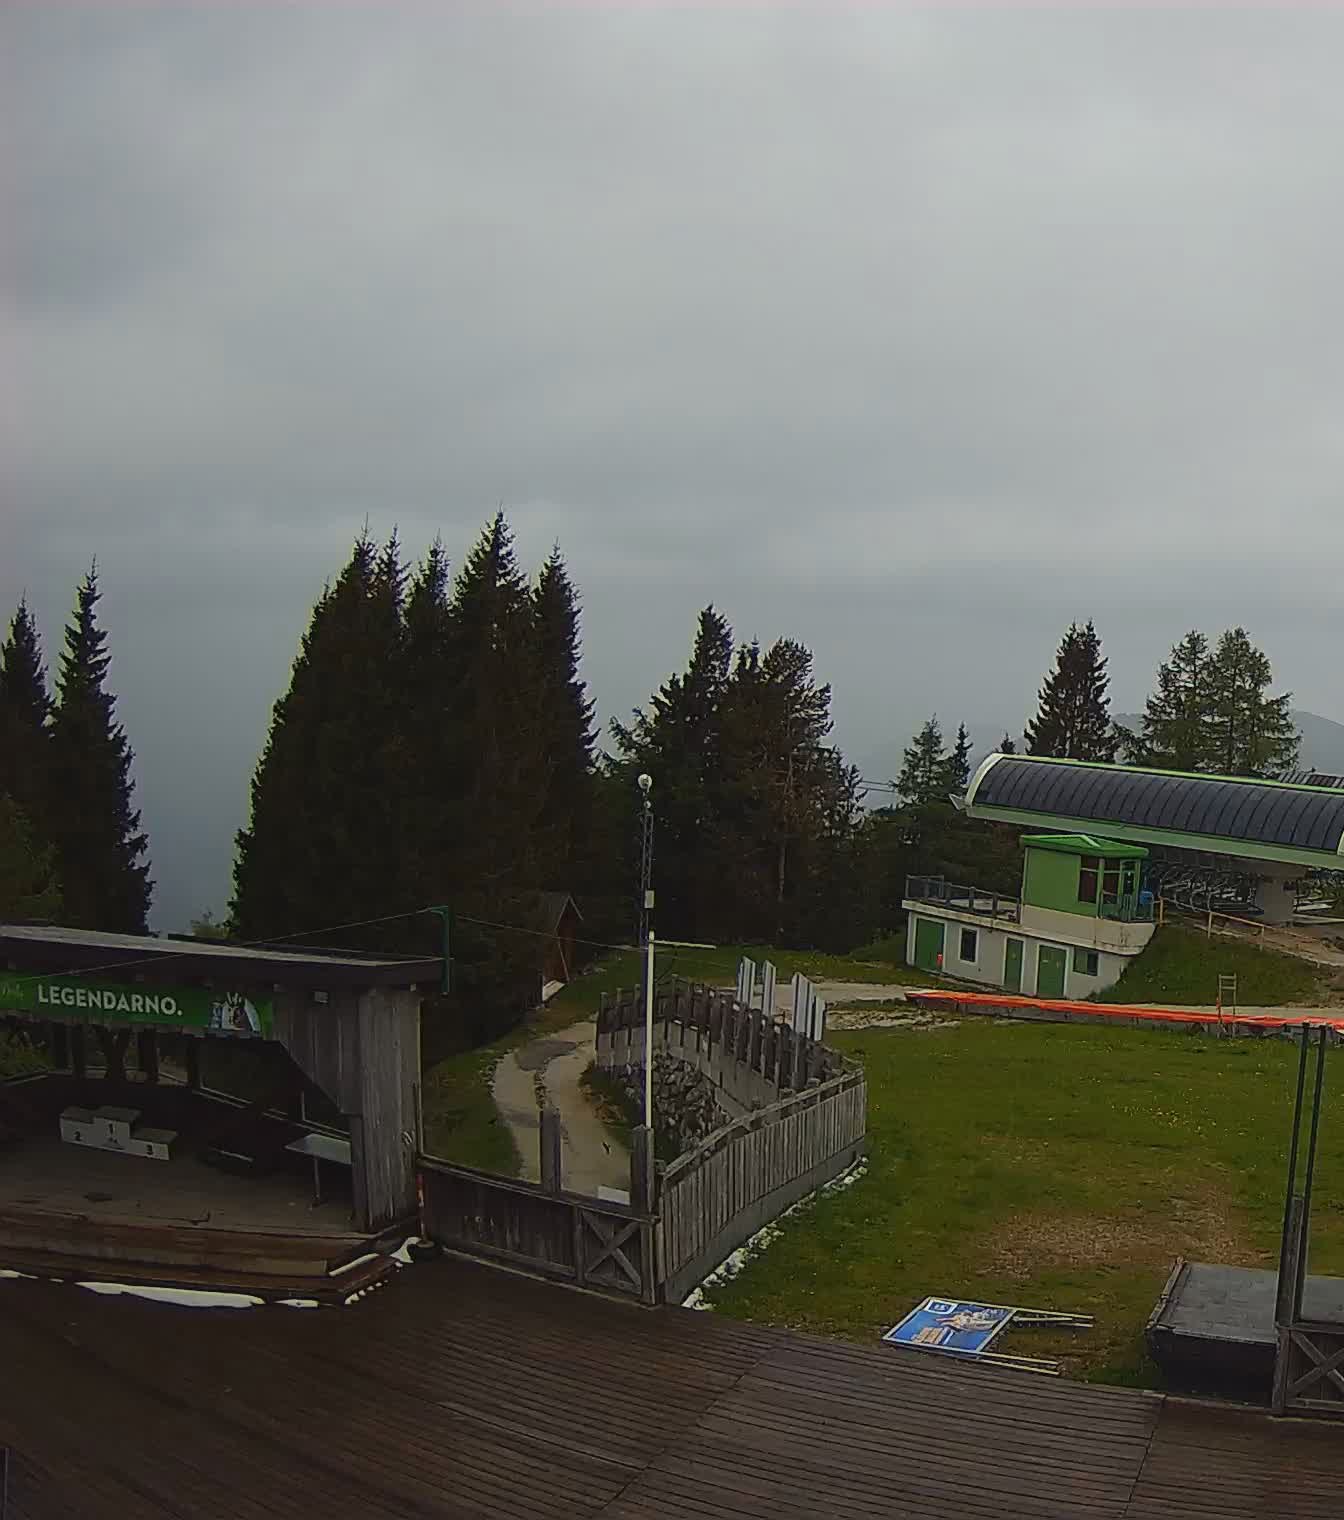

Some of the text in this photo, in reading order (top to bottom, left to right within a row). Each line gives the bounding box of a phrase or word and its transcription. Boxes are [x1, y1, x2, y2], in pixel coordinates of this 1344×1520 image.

[38, 984, 183, 1016] LEGENDARNO.
[73, 1131, 81, 1142] 2
[145, 1145, 153, 1156] 3
